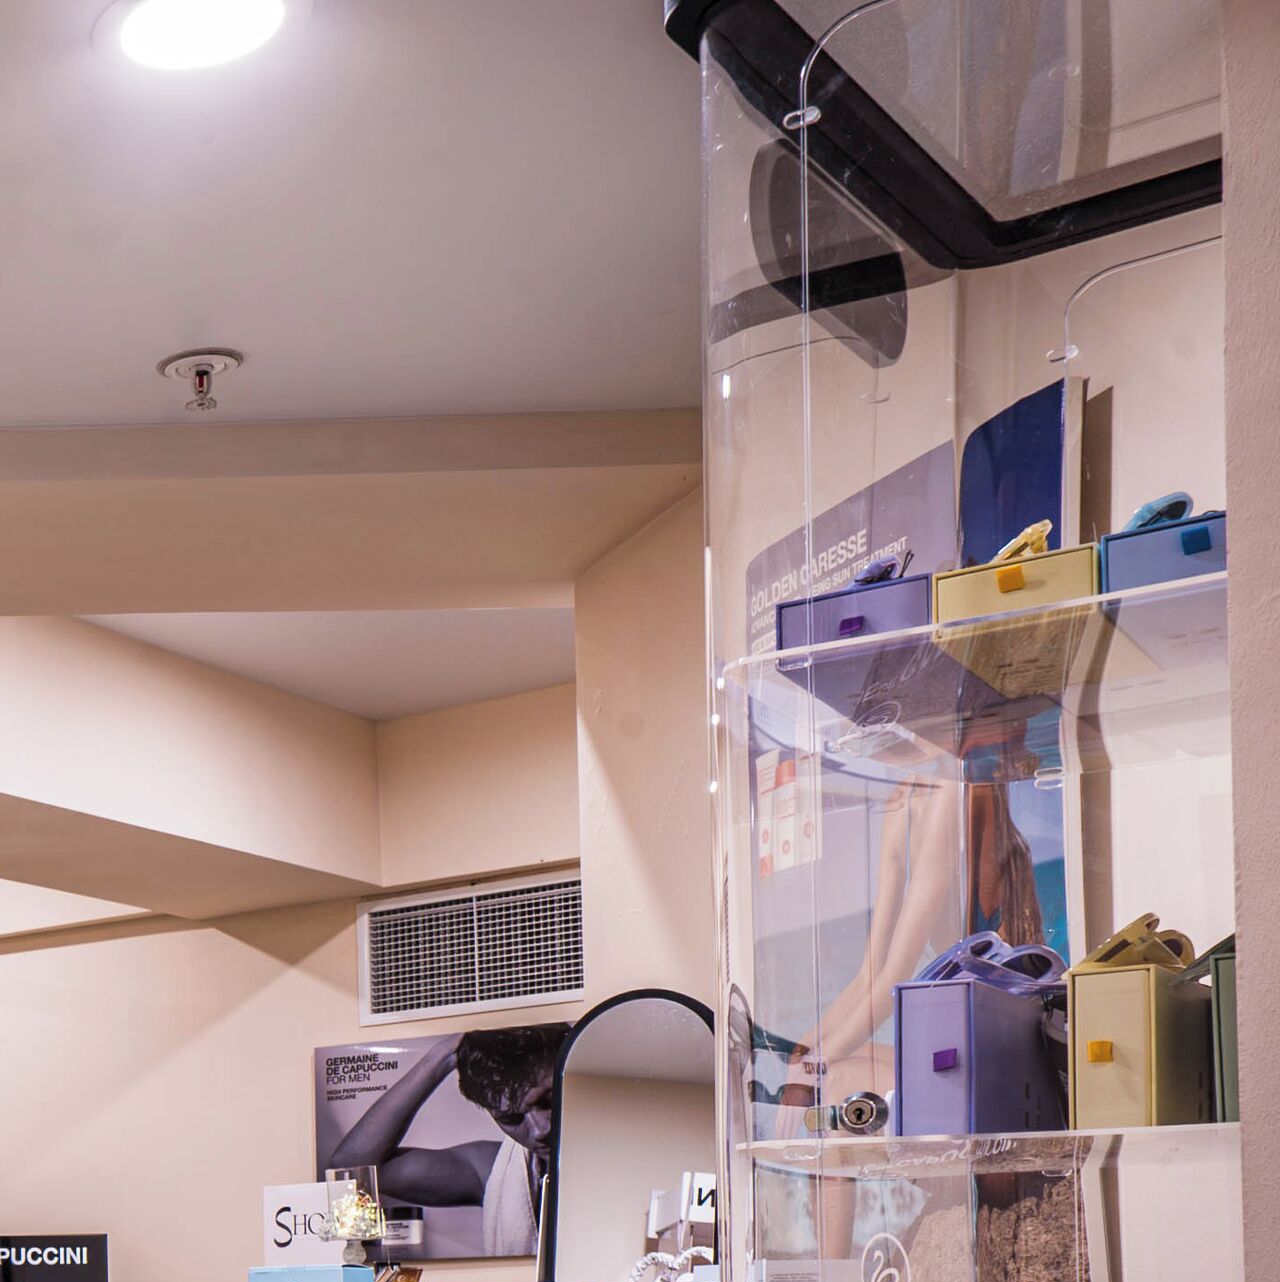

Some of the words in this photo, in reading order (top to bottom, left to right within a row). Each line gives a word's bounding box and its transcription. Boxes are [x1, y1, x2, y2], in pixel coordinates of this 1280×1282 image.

[751, 572, 798, 617] GOLDEN
[800, 528, 868, 586] CARESSE
[326, 1053, 379, 1066] GERMAINE
[326, 1066, 340, 1076] DE
[342, 1061, 398, 1075] CAPUCCINI
[326, 1075, 346, 1085] FOR
[348, 1073, 371, 1083] MEN
